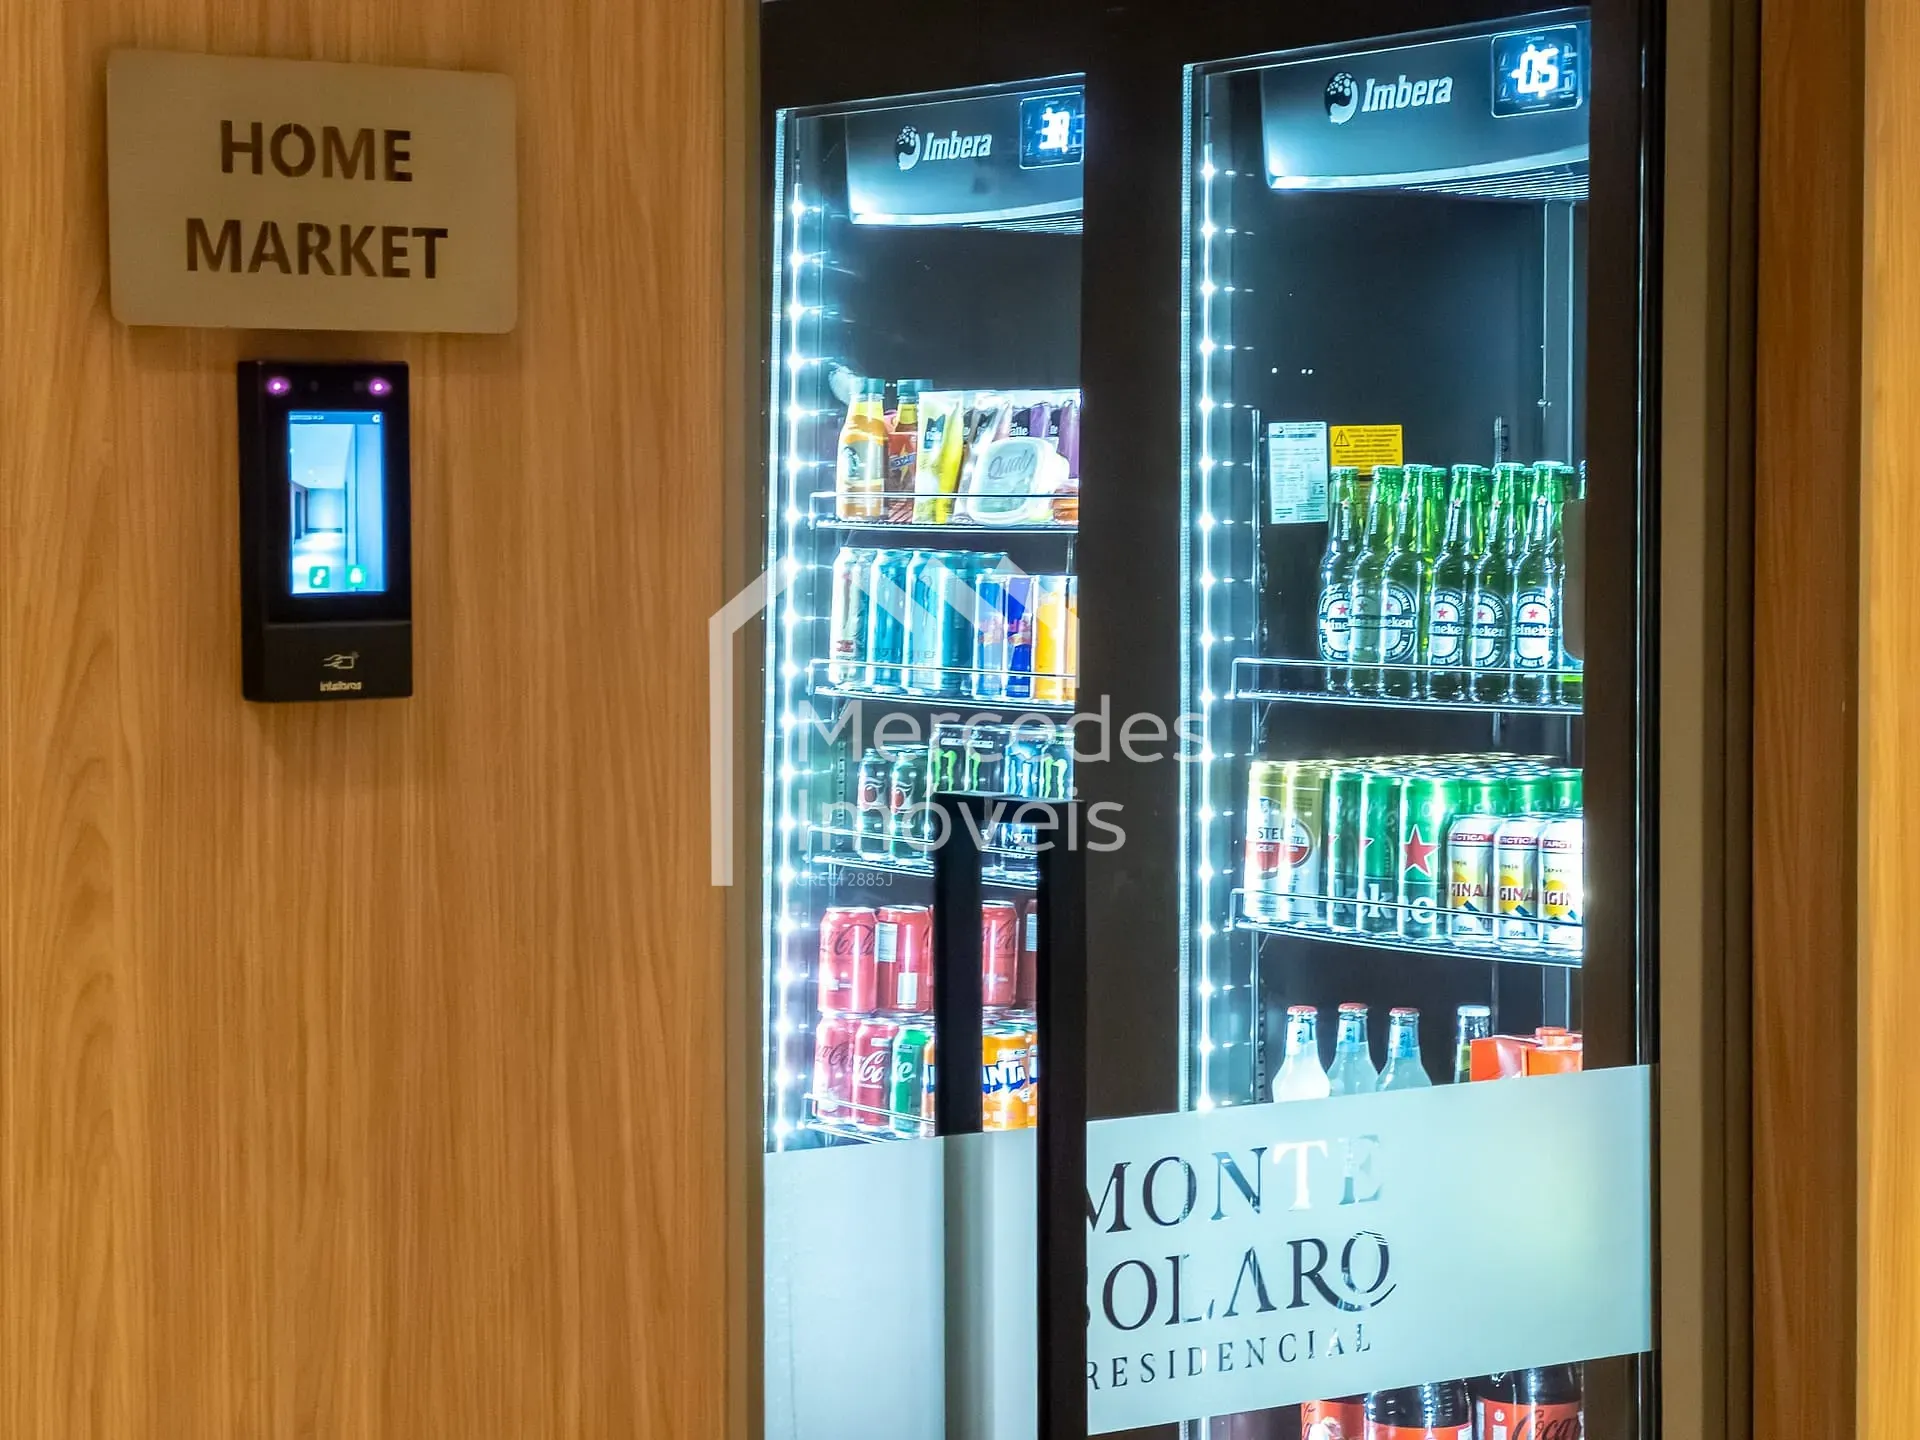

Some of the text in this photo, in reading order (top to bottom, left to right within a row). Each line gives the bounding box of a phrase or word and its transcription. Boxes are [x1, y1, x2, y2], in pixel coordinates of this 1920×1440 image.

[1361, 75, 1454, 112] Imbera
[220, 120, 413, 181] HOME
[922, 130, 992, 161] Imbera
[186, 217, 448, 279] MARKET
[1087, 1133, 1385, 1234] MONTE
[1087, 1230, 1397, 1332] OLARO
